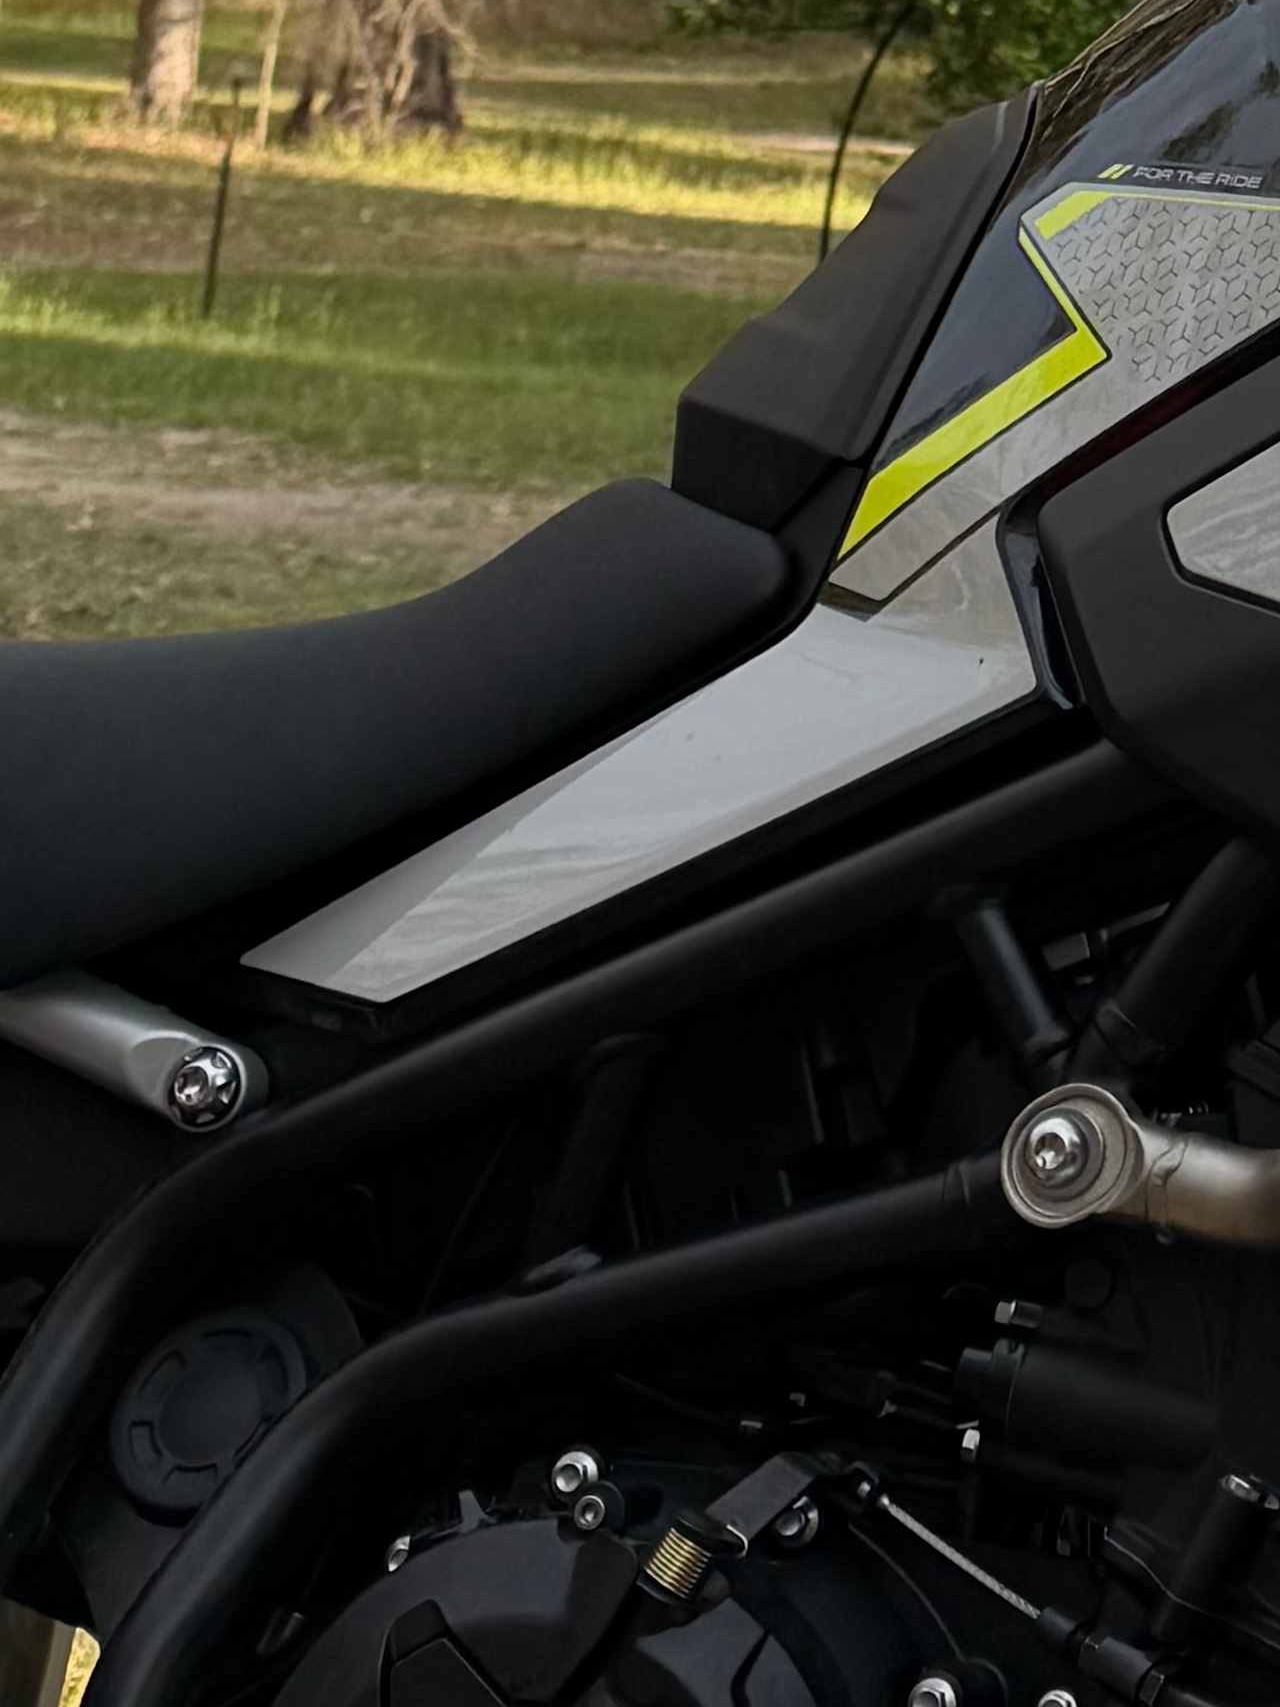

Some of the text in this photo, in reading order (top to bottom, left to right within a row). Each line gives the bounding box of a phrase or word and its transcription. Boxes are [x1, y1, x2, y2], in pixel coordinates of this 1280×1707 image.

[1132, 166, 1263, 189] FOR THE RIDE
